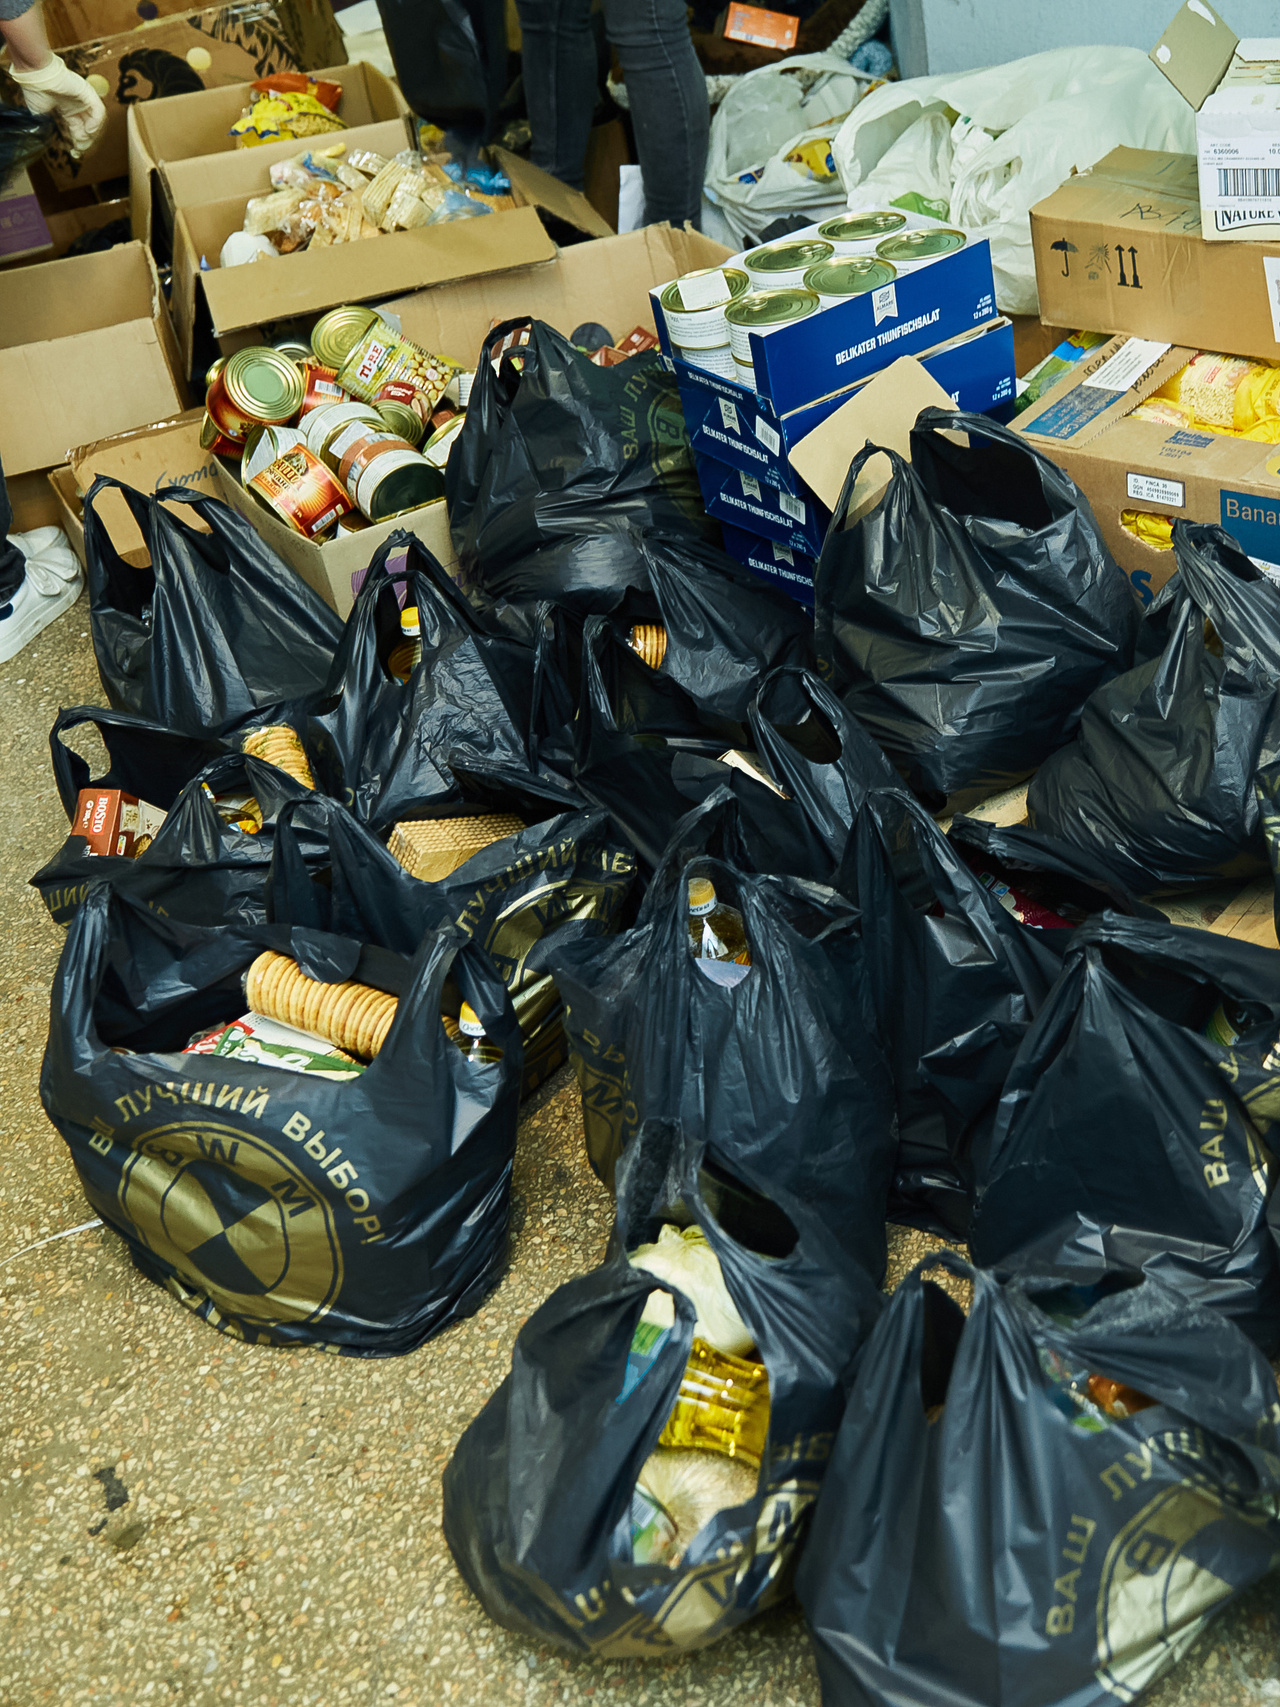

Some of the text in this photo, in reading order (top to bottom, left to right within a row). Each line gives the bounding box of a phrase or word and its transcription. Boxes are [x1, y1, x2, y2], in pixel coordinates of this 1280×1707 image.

[835, 308, 940, 365] DELIKATER THUNFISCHSALAT
[702, 424, 770, 464] DELIKATER THUNFISCHSALAT
[720, 491, 794, 528] DELIKATER THUNFISCHSALAT
[748, 557, 814, 588] DELIKATER THUNFISCHS
[92, 797, 109, 833] BOSTO
[114, 1081, 271, 1122] ЛУЧШИЙ
[281, 1109, 386, 1245] ВЫБОР!
[1045, 1513, 1097, 1636] ВАШ
